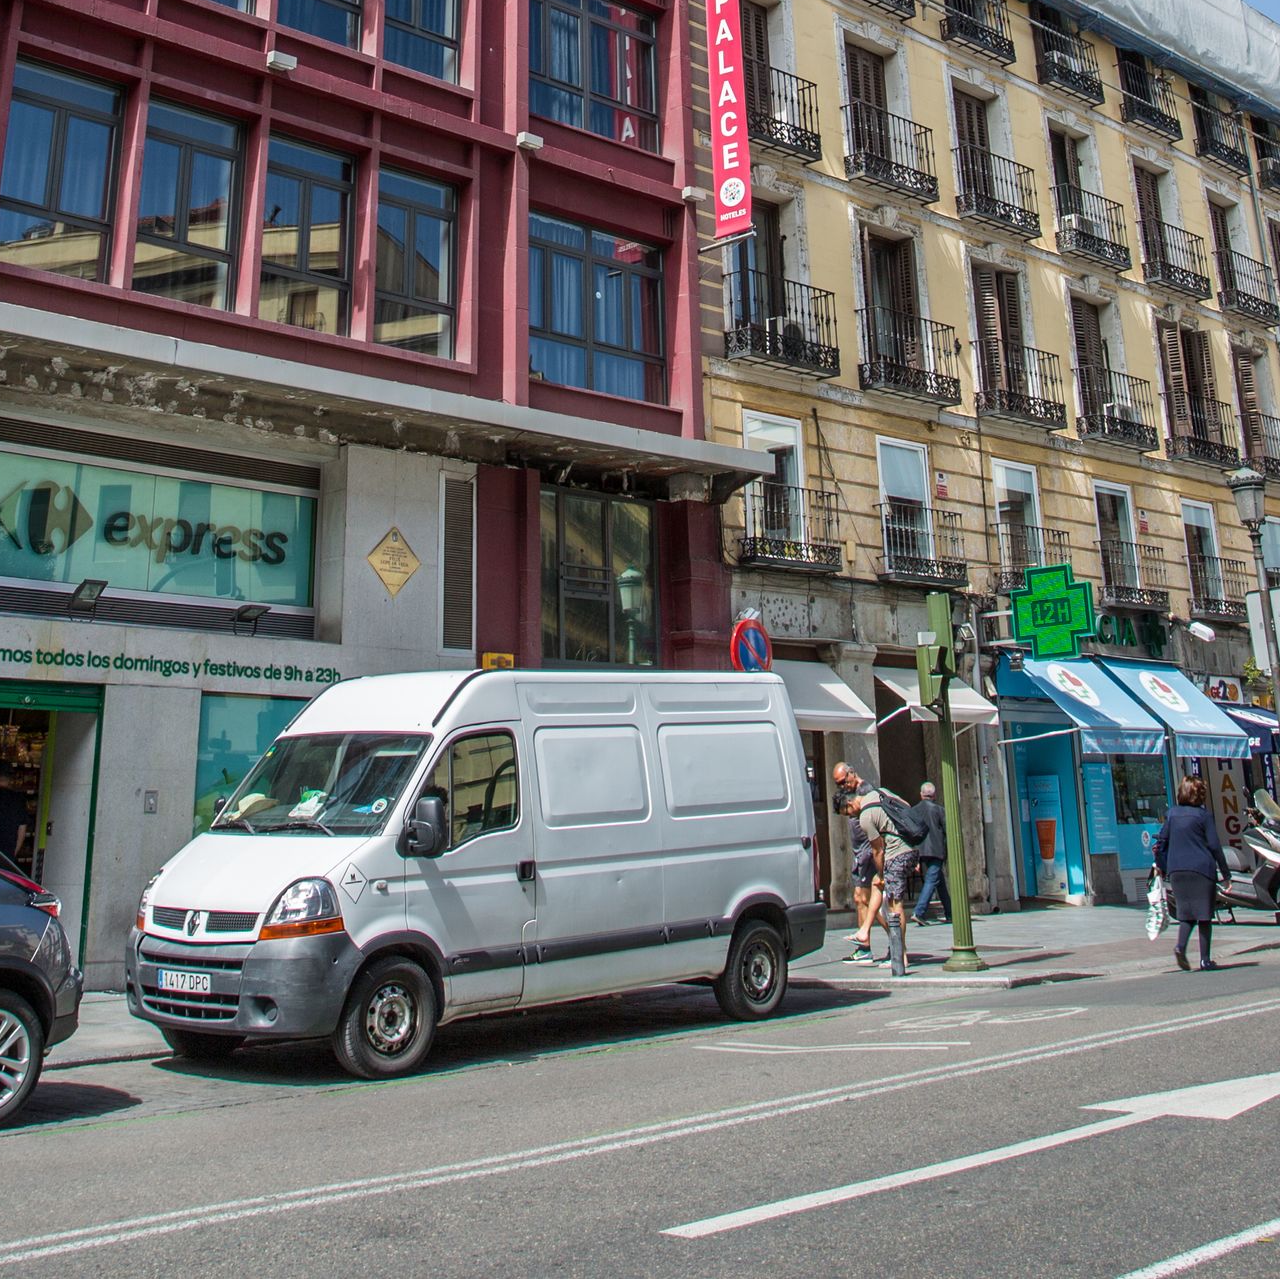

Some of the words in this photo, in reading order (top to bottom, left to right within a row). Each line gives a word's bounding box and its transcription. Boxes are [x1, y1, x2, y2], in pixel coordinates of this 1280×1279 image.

[720, 208, 747, 222] HOTELES
[103, 511, 288, 565] express
[1033, 601, 1070, 625] 12H
[1095, 614, 1138, 647] CIA
[35, 648, 84, 667] todos
[87, 650, 110, 668] los
[113, 653, 190, 678] domingos
[192, 662, 202, 679] y
[203, 658, 261, 679] festivos
[263, 663, 282, 680] de
[283, 665, 303, 682] 9h
[304, 670, 314, 682] a
[315, 667, 341, 684] 23h
[1217, 758, 1242, 850] HANGE
[165, 972, 186, 989] 1417
[189, 974, 208, 991] DPC
